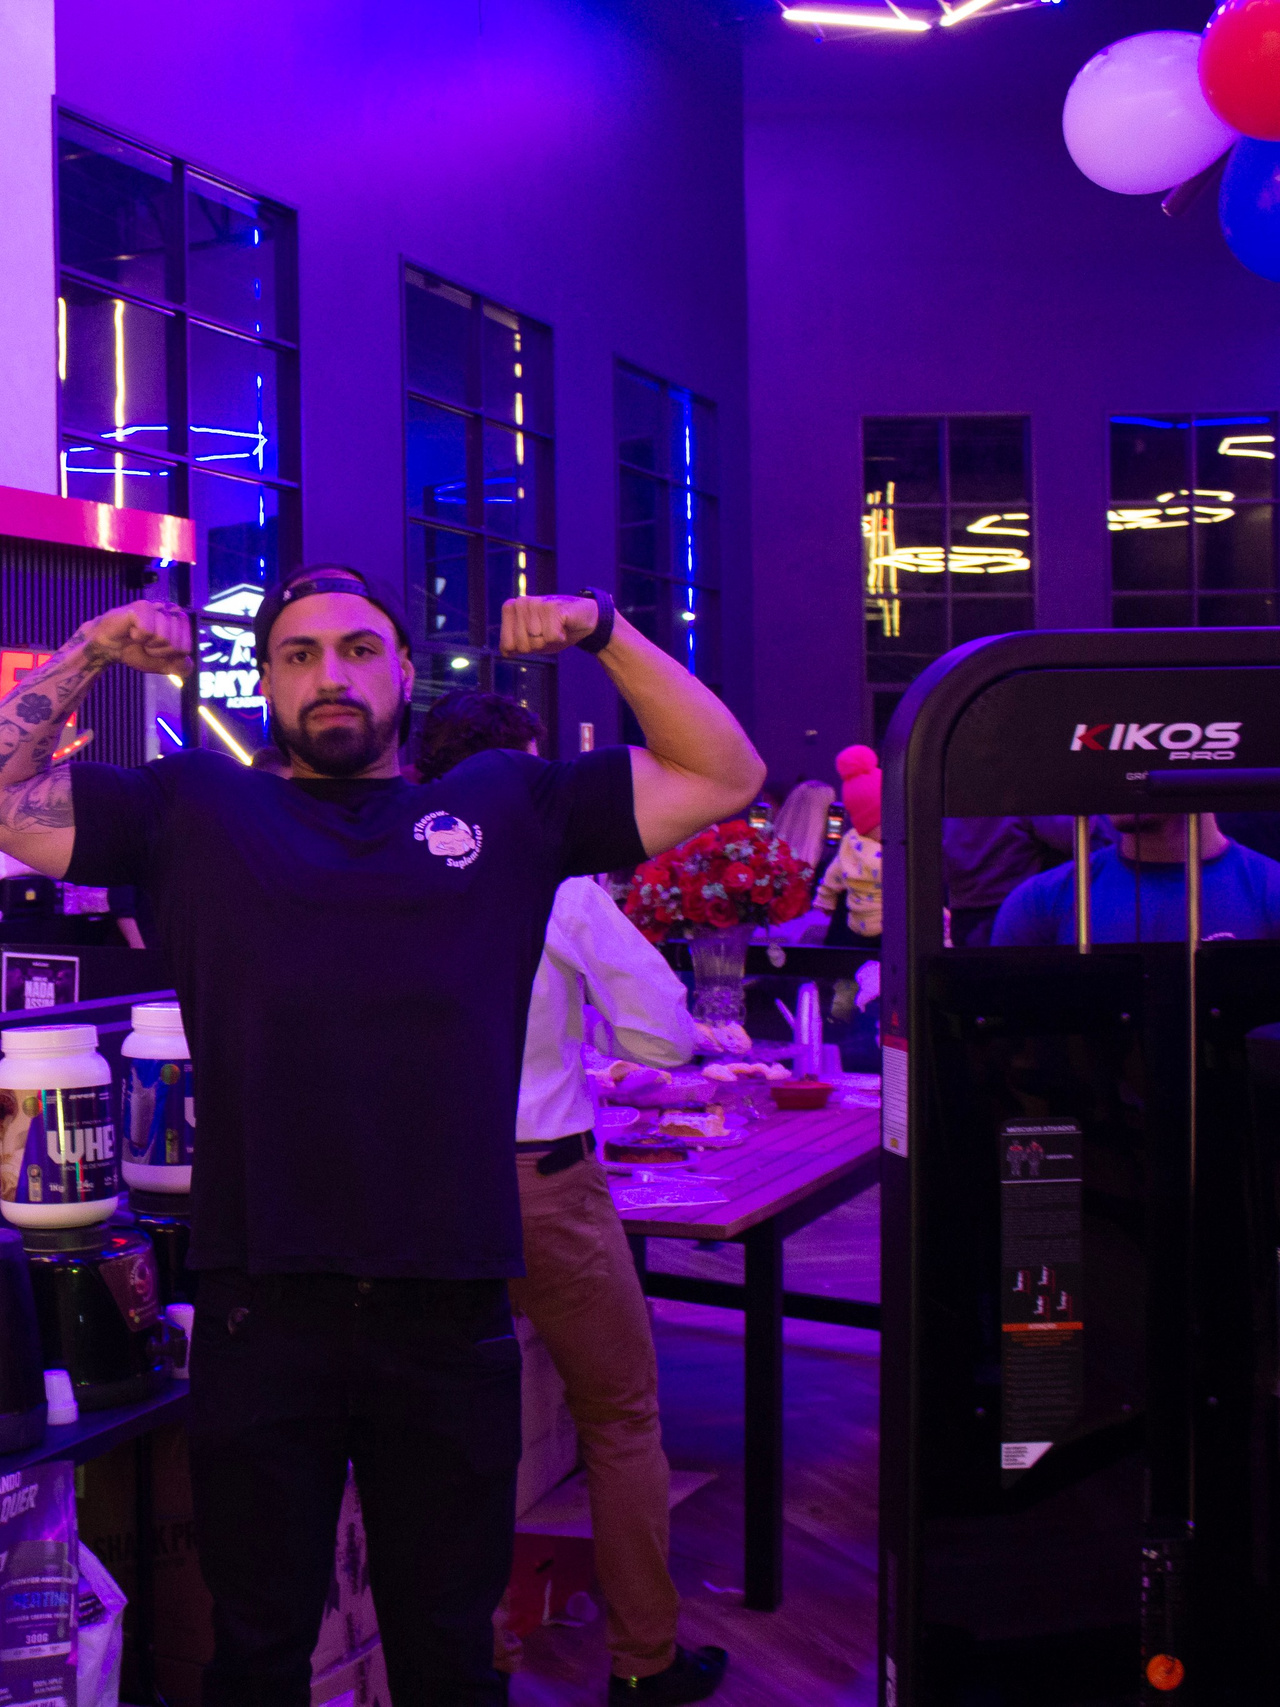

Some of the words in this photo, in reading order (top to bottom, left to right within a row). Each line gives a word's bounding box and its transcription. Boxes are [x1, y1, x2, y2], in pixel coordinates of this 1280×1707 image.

[1069, 721, 1243, 751] KIKOS
[1168, 750, 1237, 761] PRO
[46, 1124, 114, 1165] WHE
